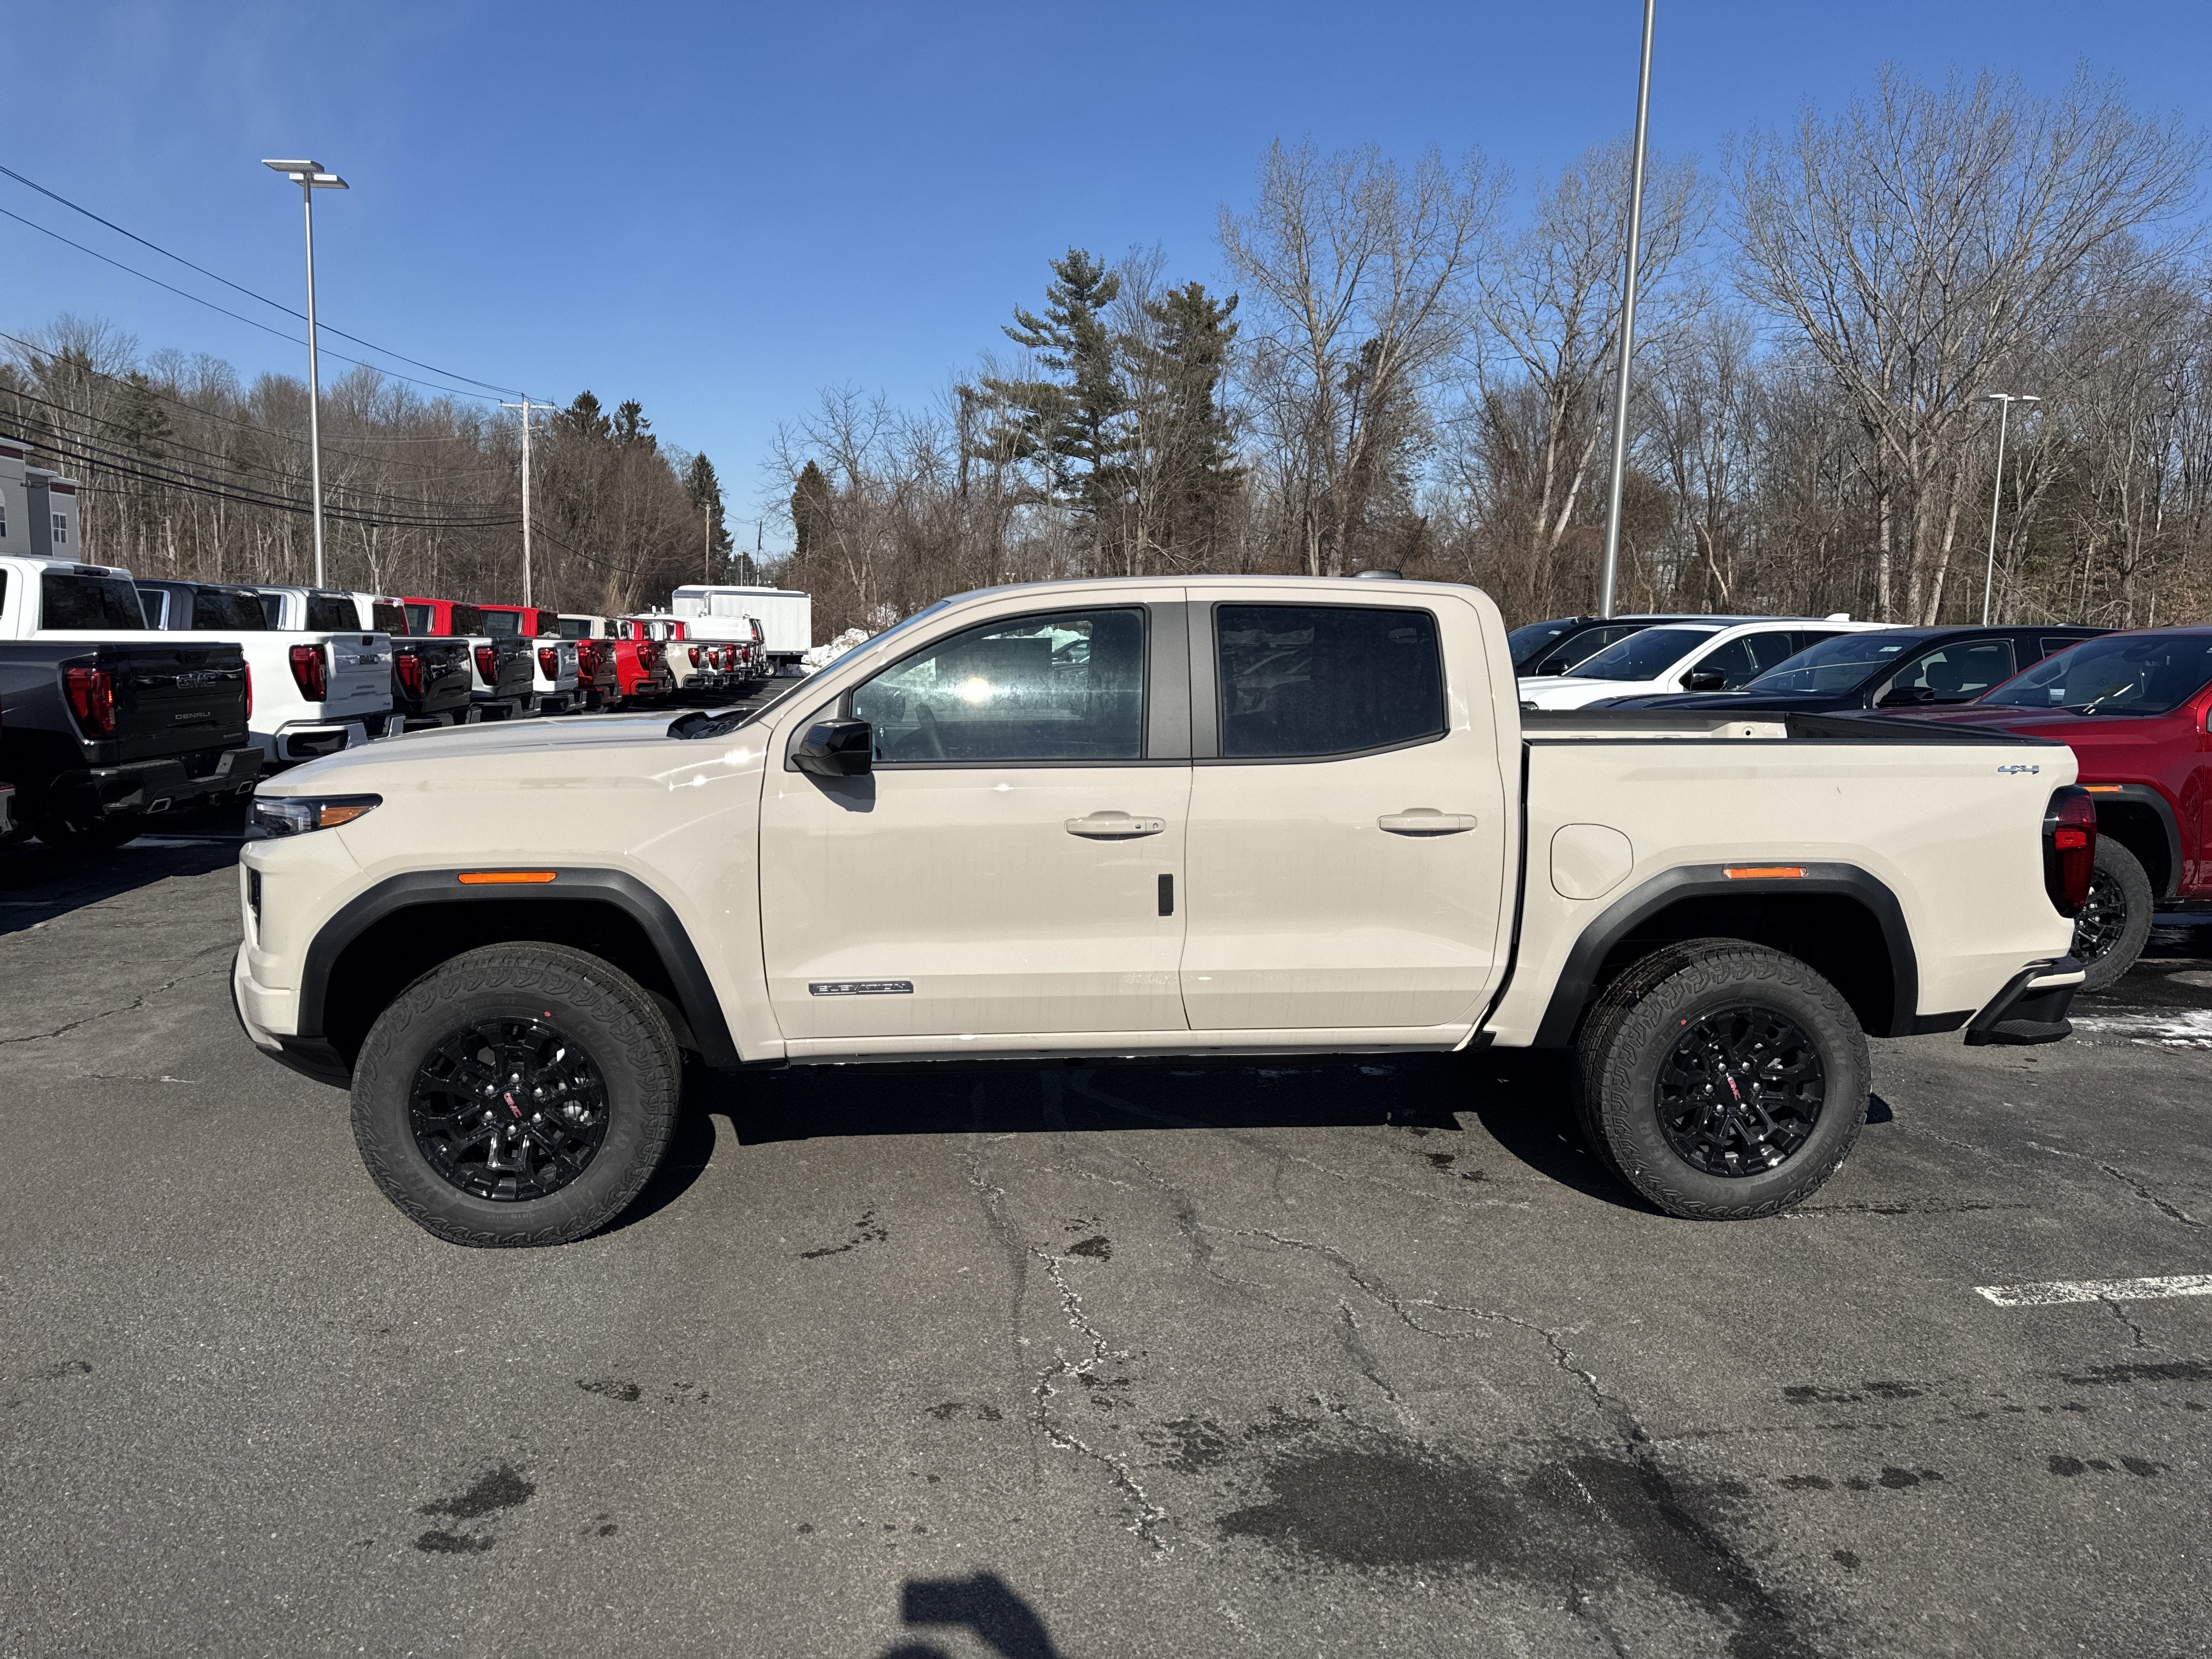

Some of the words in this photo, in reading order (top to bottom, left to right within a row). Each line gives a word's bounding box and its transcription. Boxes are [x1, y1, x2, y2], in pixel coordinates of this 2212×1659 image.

[176, 673, 216, 689] GMC
[175, 712, 211, 720] DENALI
[574, 1019, 632, 1150] GOODEAR
[1728, 1076, 1741, 1101] GMC
[504, 1092, 522, 1119] GMC
